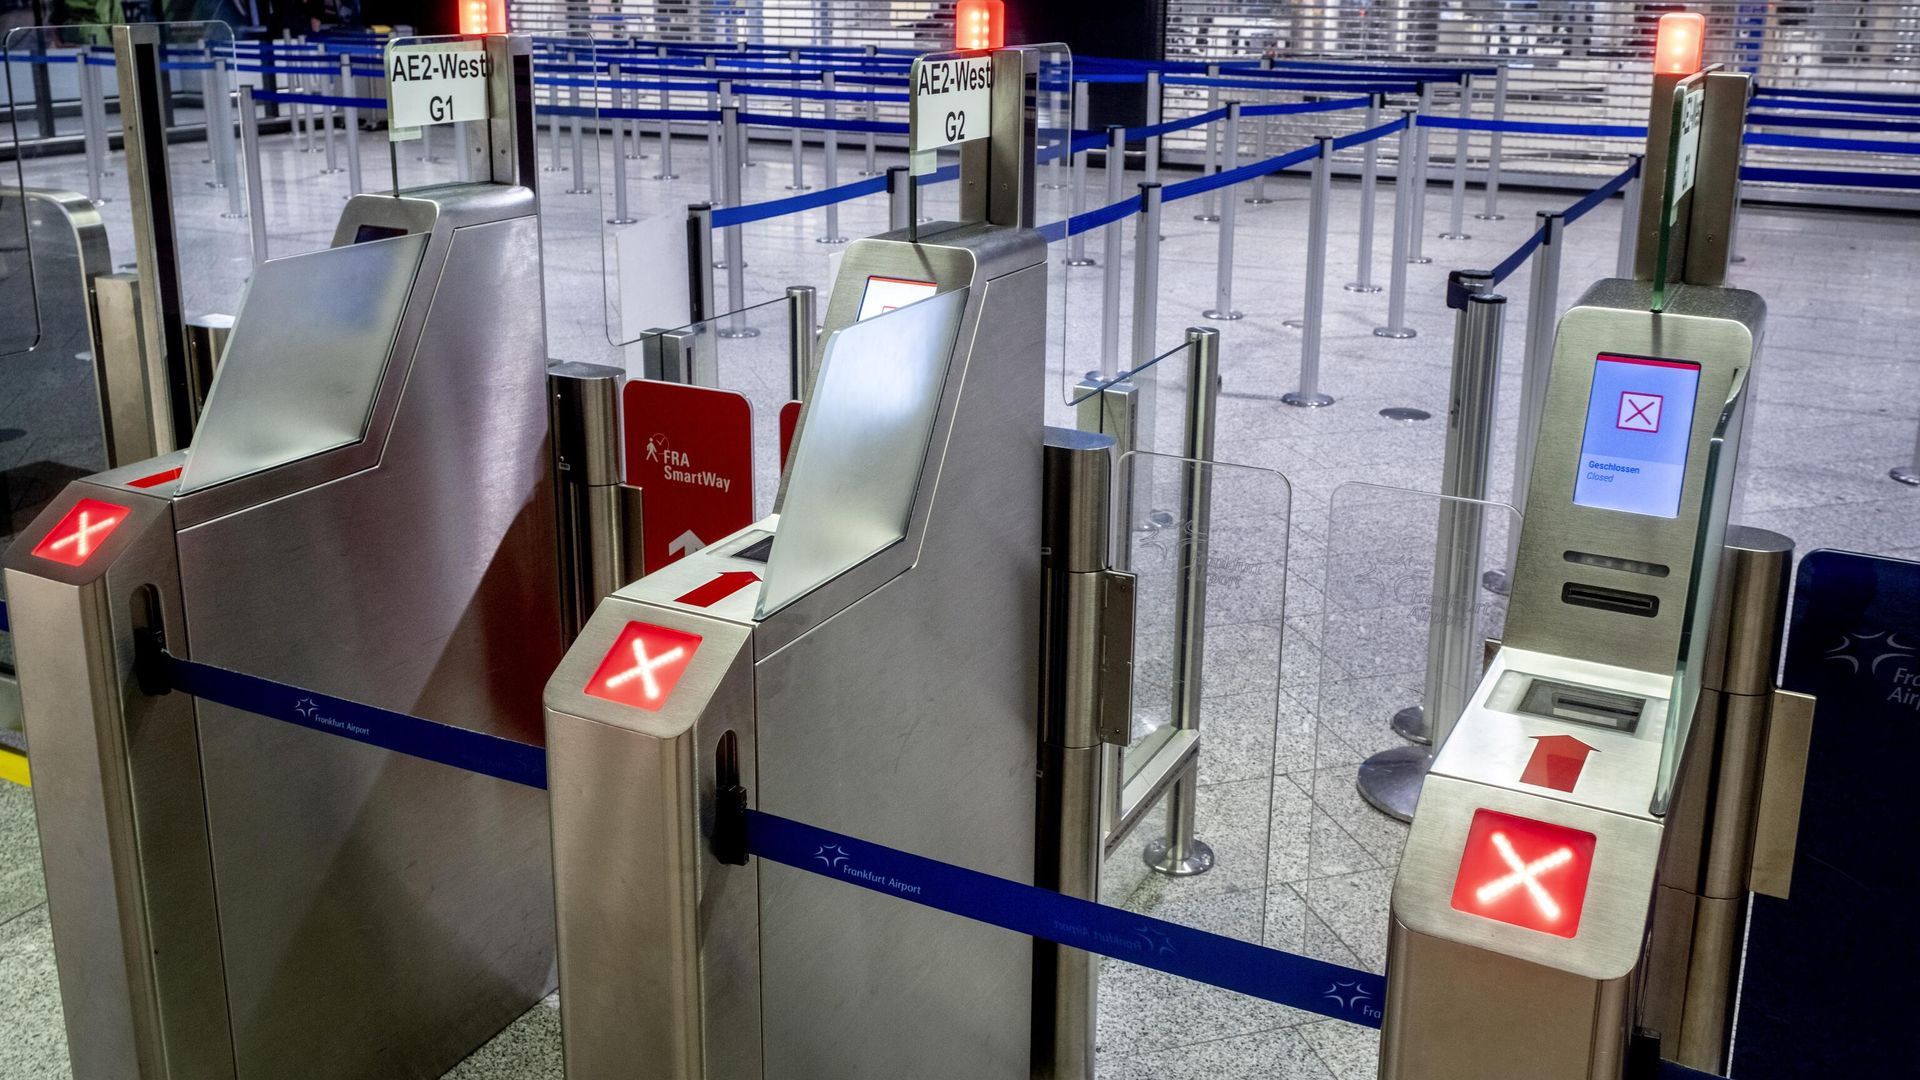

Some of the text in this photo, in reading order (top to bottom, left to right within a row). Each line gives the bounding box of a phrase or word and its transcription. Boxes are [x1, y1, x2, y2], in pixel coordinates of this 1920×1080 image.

[391, 53, 487, 81] AE2-West
[917, 61, 991, 96] AE2-West
[429, 95, 454, 121] G1
[945, 111, 965, 142] G2
[663, 449, 690, 468] FRA
[1588, 460, 1640, 474] Geschlossen
[663, 465, 731, 493] SmartWay
[1586, 471, 1614, 483] Closed
[315, 714, 369, 735] Frankfurt Airport
[843, 864, 921, 894] Frankfurt Airport
